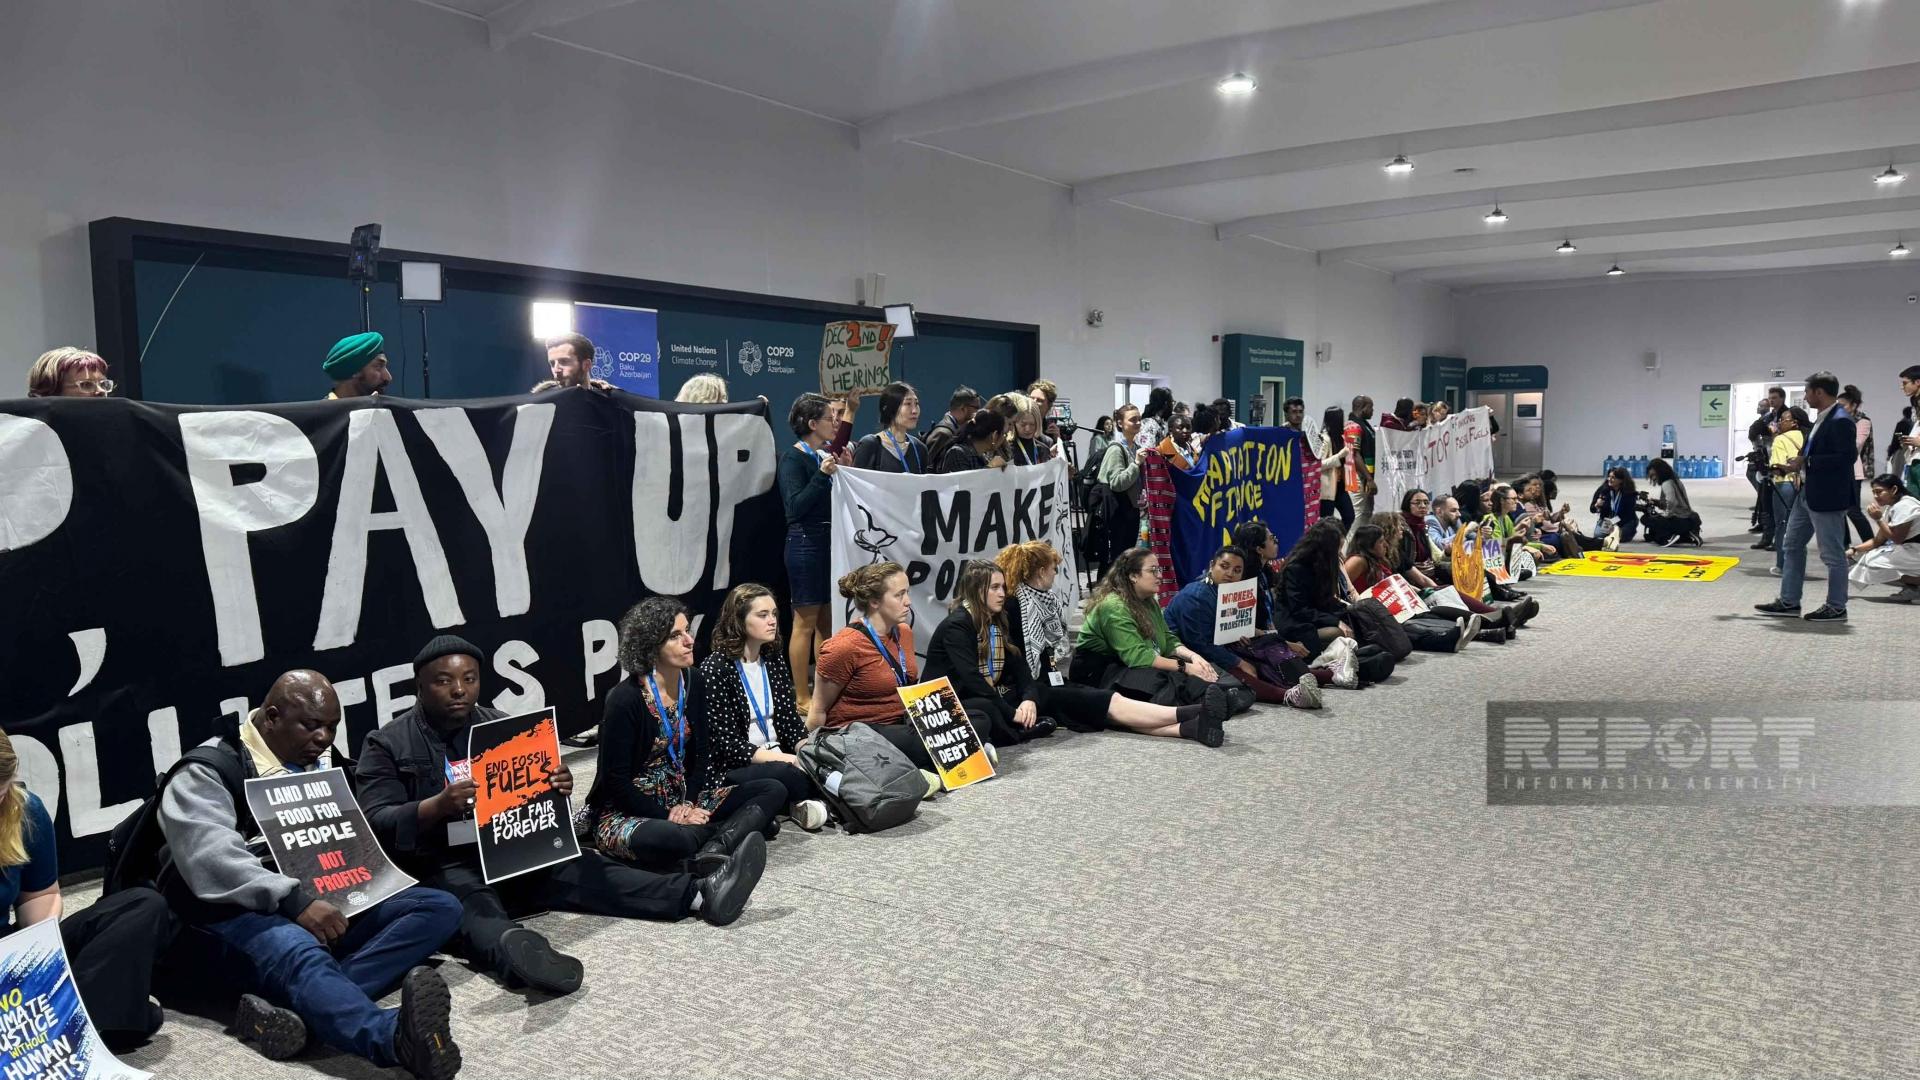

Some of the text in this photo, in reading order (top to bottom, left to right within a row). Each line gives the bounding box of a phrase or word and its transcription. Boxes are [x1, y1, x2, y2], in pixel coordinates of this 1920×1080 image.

[826, 326, 845, 348] DEC
[618, 351, 651, 364] COP29
[670, 343, 717, 355] United Nations
[766, 346, 794, 357] COP29
[619, 363, 635, 371] Baku
[671, 355, 718, 368] Climate Change
[767, 358, 781, 366] Baku
[767, 366, 795, 374] Azerbaijan
[827, 352, 859, 370] ORAL
[619, 370, 652, 379] Azerbaijan
[832, 363, 890, 392] HEARINGS
[920, 482, 1056, 556] MAKE
[178, 403, 556, 667] PAY
[633, 410, 776, 595] UP
[1222, 588, 1254, 604] WORKERS
[1219, 617, 1252, 631] TRANSITION
[1235, 608, 1252, 620] JUST
[915, 692, 943, 714] PAY
[920, 710, 952, 730] YOUR
[925, 725, 970, 748] CLIMATE
[485, 759, 508, 775] END
[512, 750, 552, 769] FOSSIL
[938, 742, 969, 764] DEBT
[485, 761, 553, 799] FUELS
[265, 780, 332, 806] LAND AND
[275, 801, 342, 827] FOOD FOR
[491, 799, 556, 830] FAST FAIR
[281, 821, 357, 850] PEOPLE
[493, 813, 559, 845] FOREVER
[317, 850, 347, 871] NOT
[313, 866, 373, 895] PROFITS
[9, 1031, 49, 1059] WITHOUT
[3, 1034, 72, 1080] HUMAN
